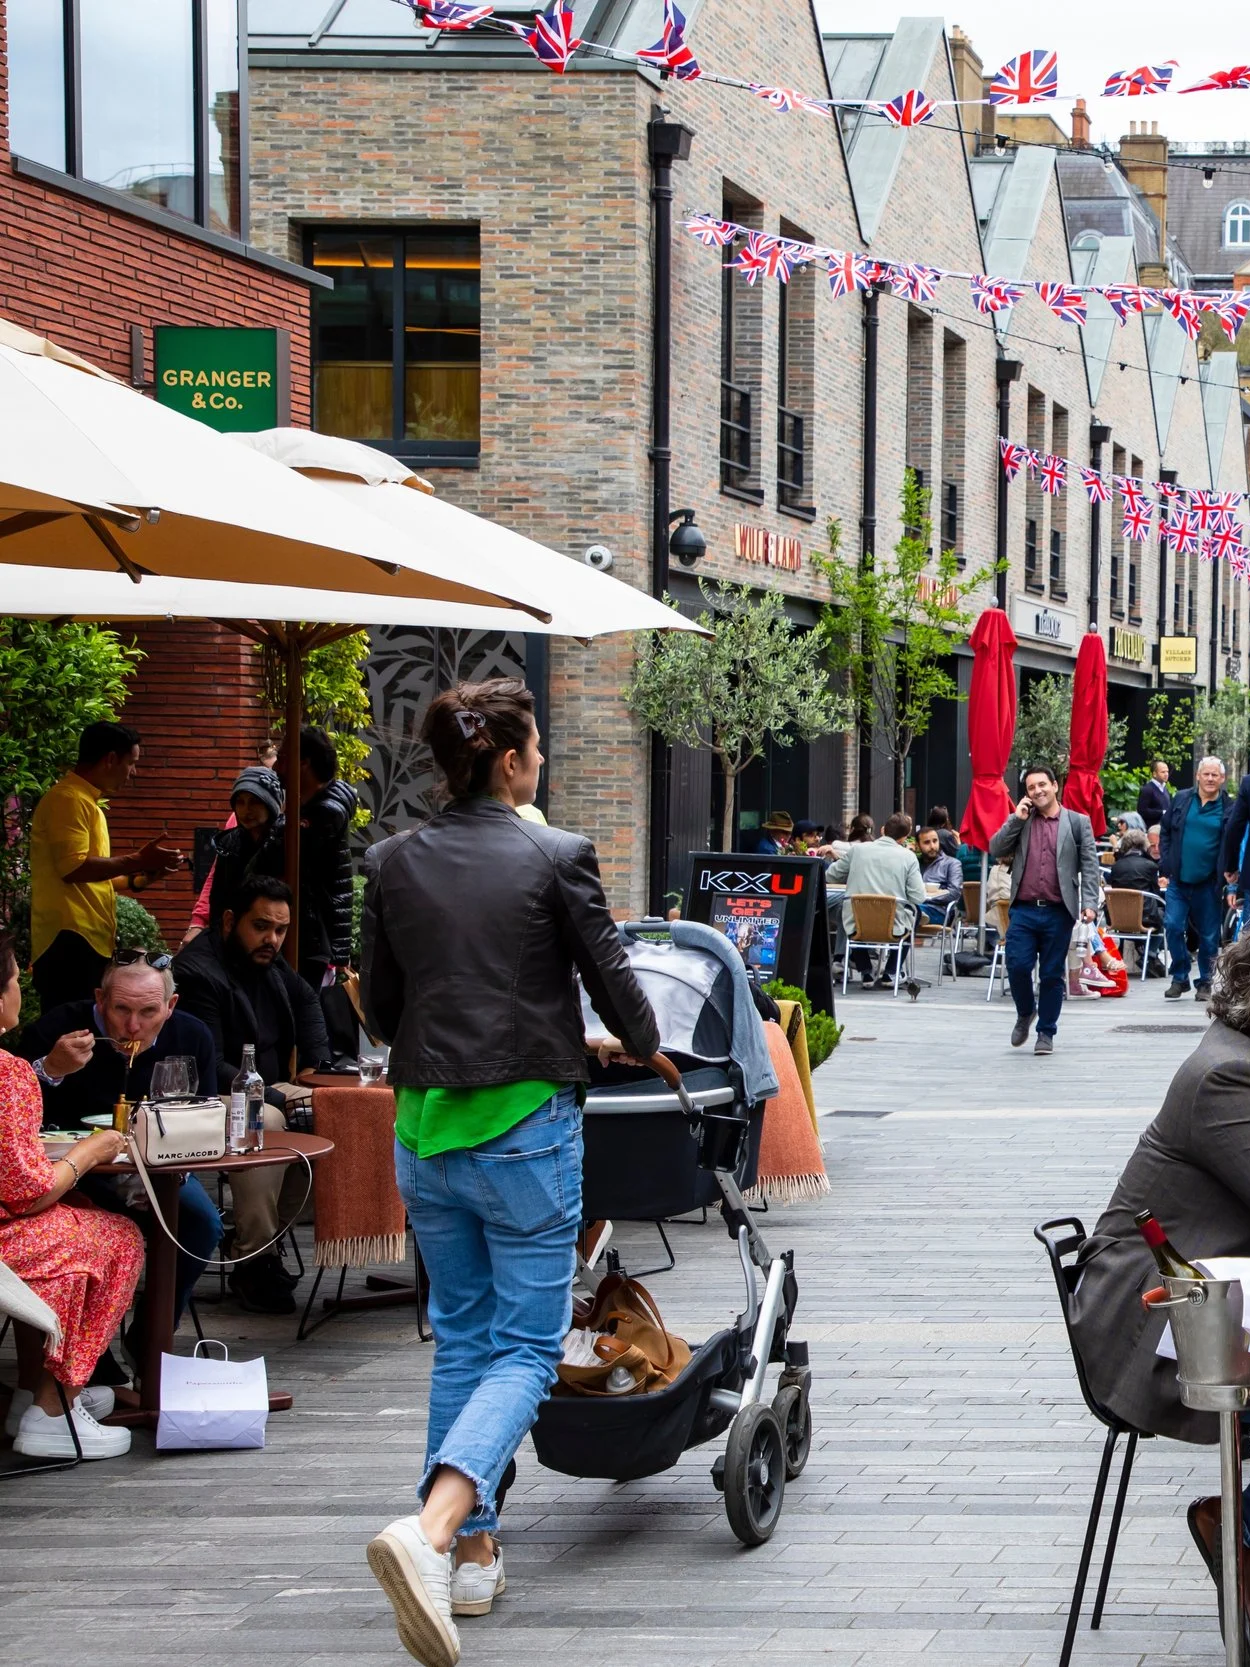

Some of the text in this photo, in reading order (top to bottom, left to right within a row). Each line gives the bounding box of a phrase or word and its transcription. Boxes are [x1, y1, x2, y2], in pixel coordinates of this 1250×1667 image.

[163, 369, 271, 388] GRANGER
[191, 392, 243, 410] & Co.
[700, 870, 803, 895] KXU
[726, 897, 772, 908] LET'S
[731, 907, 765, 916] GET
[714, 914, 780, 926] UNLIMITED
[158, 1149, 219, 1160] MARC JACOBS
